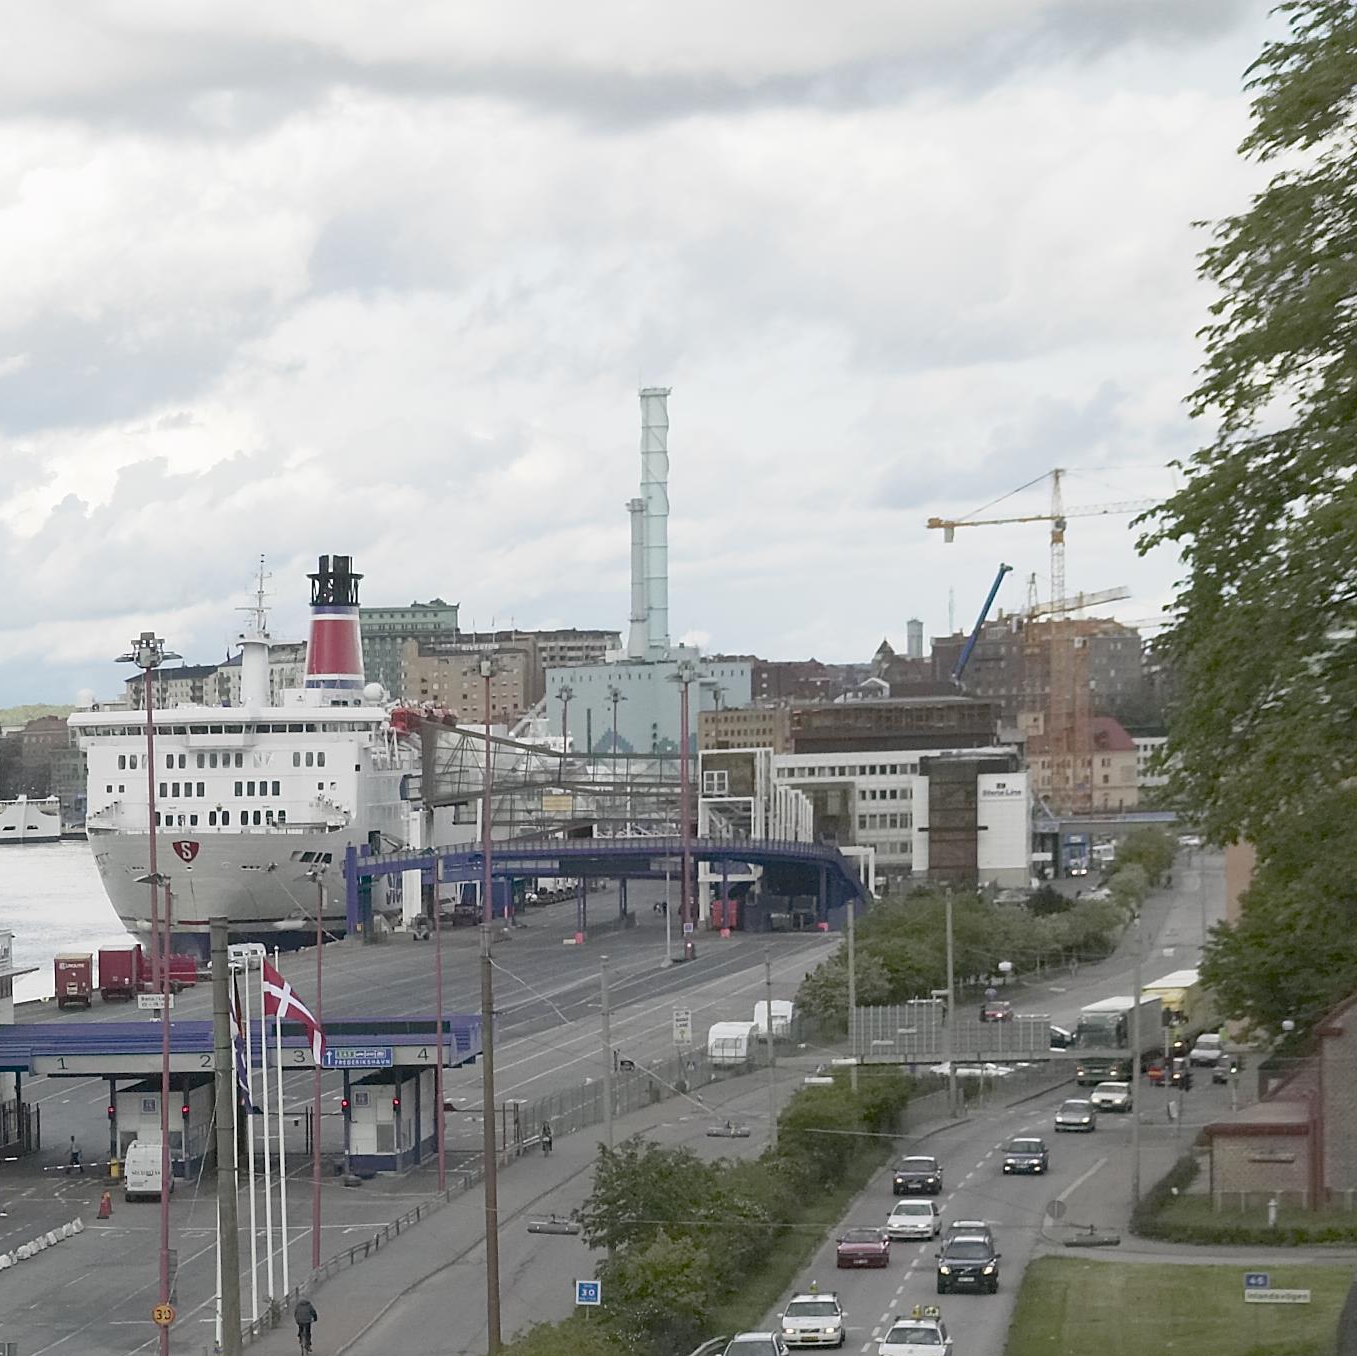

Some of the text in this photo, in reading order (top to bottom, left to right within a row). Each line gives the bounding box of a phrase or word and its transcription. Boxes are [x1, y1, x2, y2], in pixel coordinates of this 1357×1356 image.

[293, 1050, 306, 1063] 3
[417, 1047, 430, 1061] 4
[57, 1057, 68, 1070] 1
[200, 1055, 211, 1067] 2
[581, 1288, 595, 1296] 30
[156, 1309, 172, 1320] 30
